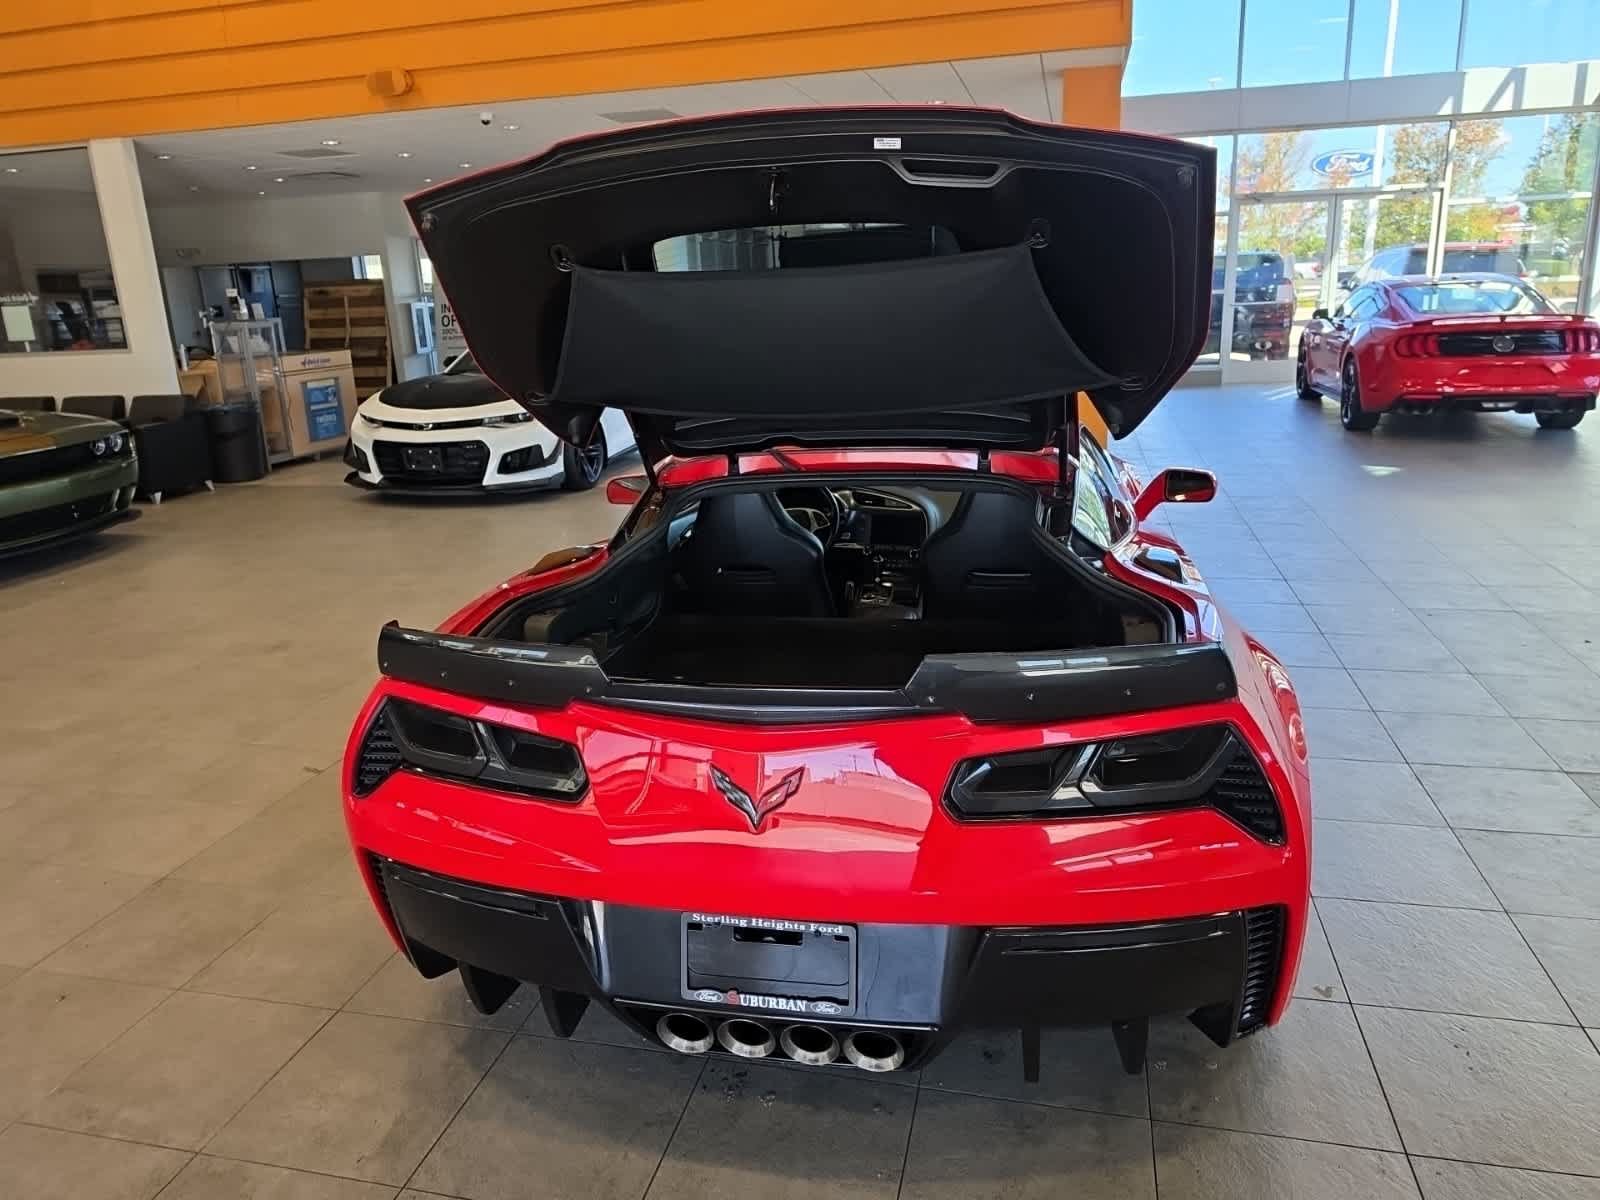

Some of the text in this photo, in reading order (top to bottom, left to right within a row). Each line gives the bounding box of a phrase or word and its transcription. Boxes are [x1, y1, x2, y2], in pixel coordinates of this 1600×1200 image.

[1324, 153, 1372, 173] Ford
[692, 913, 843, 934] Sterling Heights Ford
[727, 990, 806, 1012] SUBURBAN
